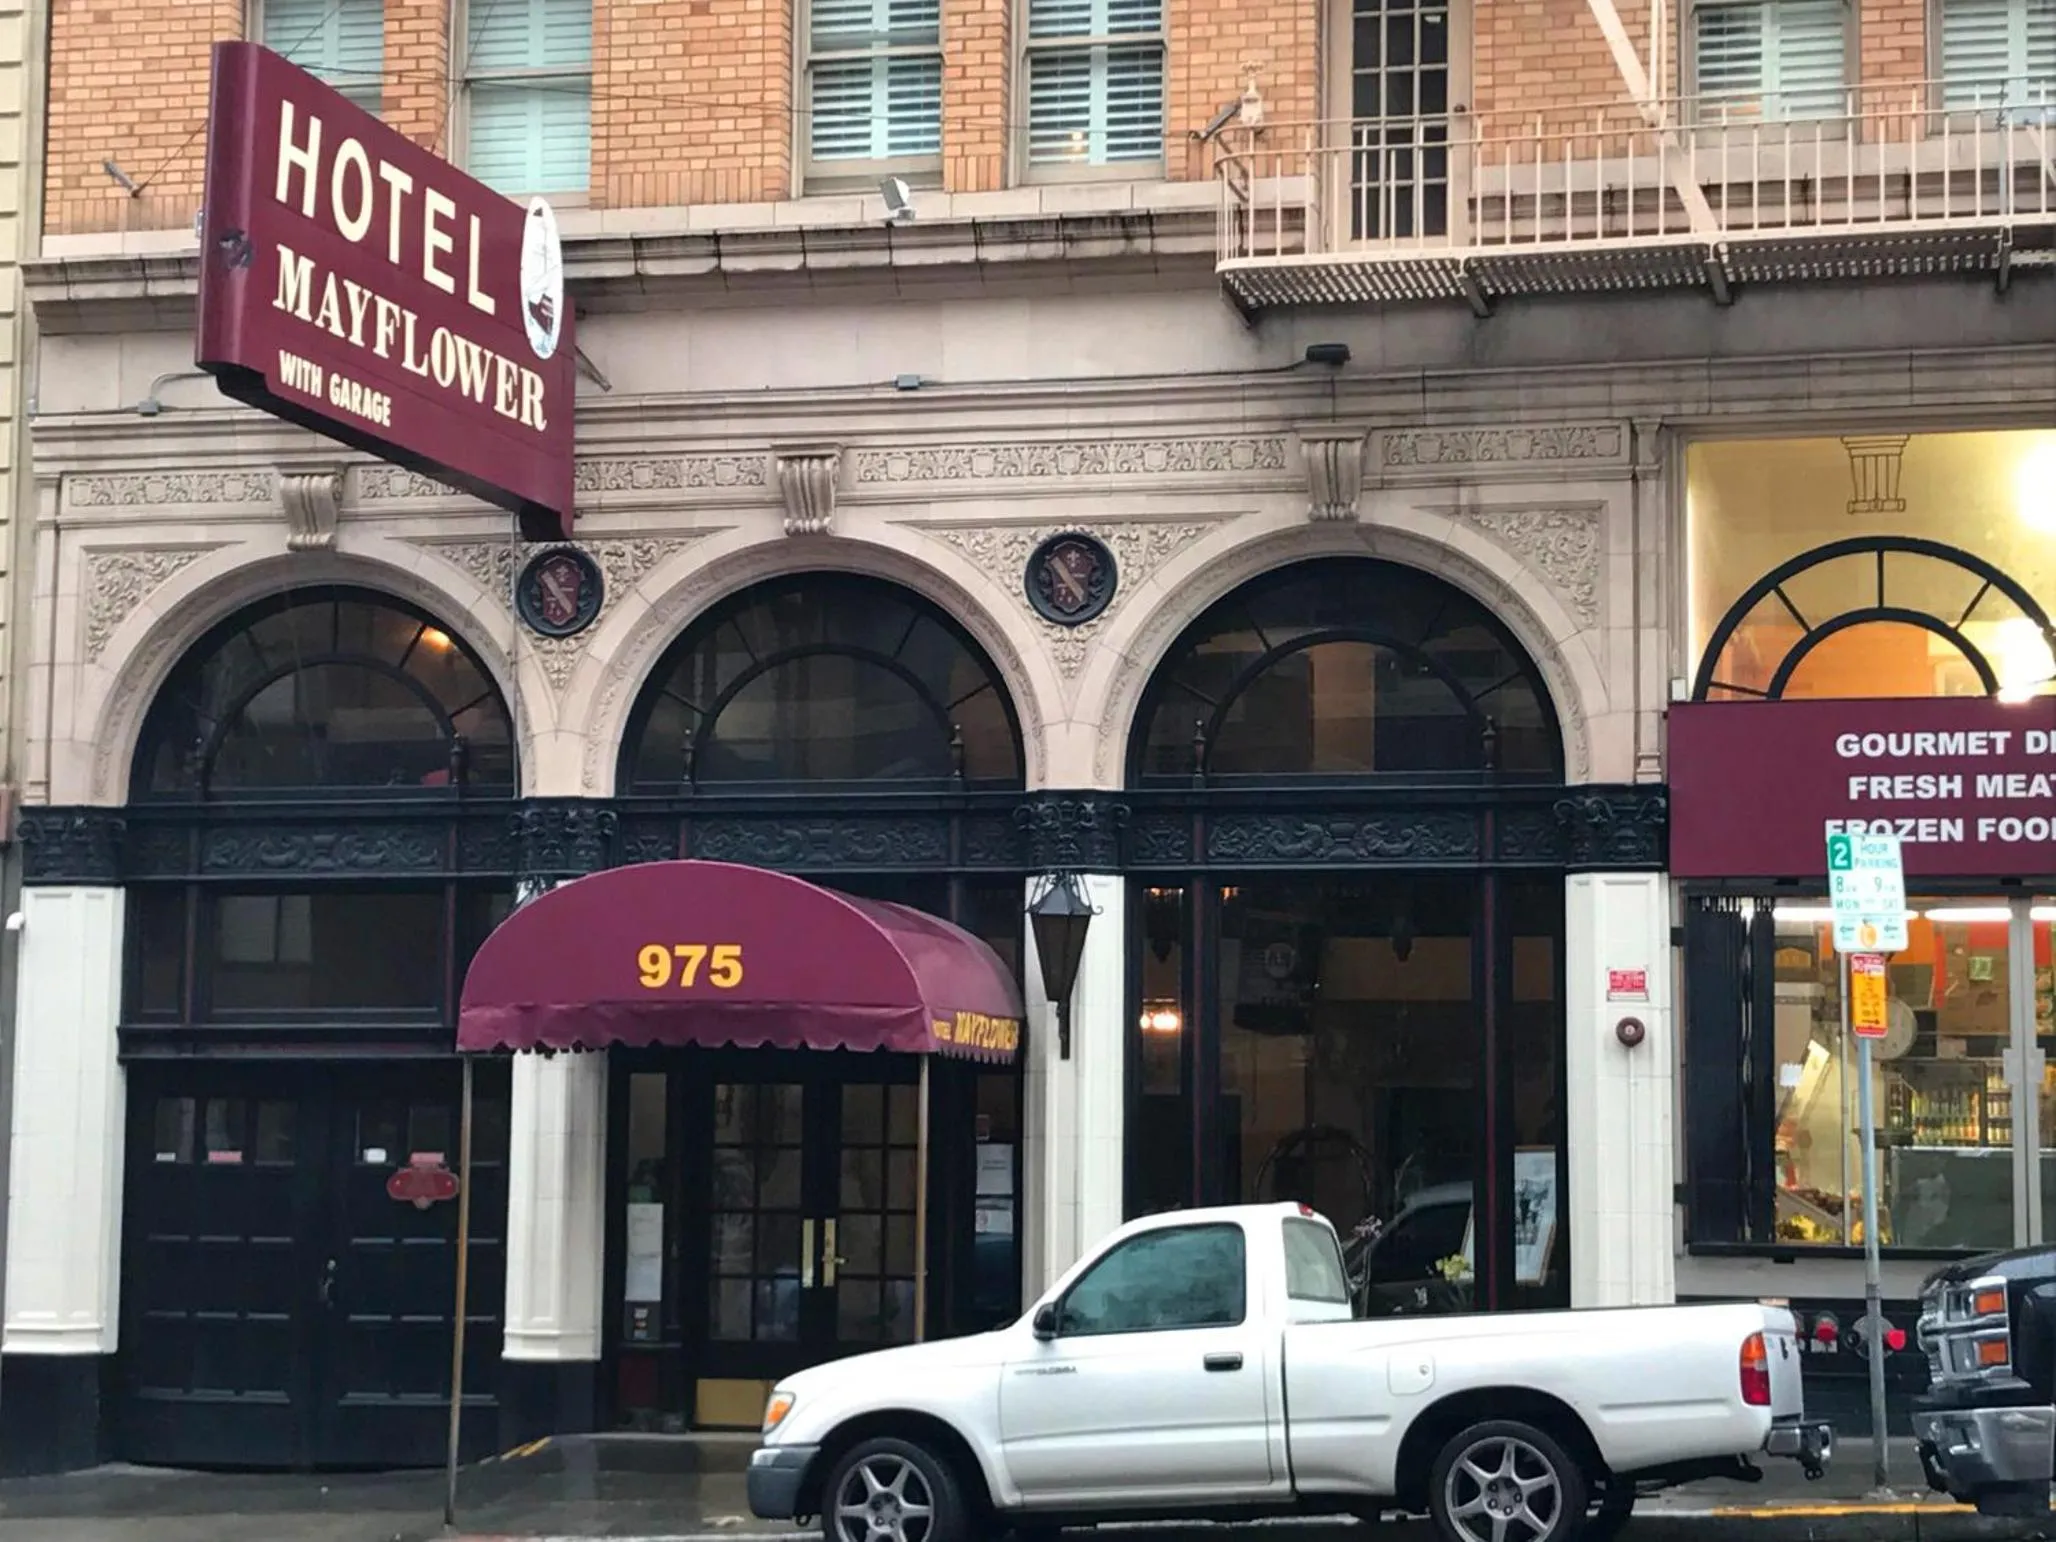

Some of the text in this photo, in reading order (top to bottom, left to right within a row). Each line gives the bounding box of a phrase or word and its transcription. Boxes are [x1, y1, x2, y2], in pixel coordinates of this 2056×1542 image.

[275, 99, 496, 316] HOTEL
[272, 243, 548, 432] MAYFLOWER
[279, 349, 392, 428] WITH GARAGE
[1835, 730, 2056, 758] GOURMET D
[1849, 773, 2056, 800] FRESH MEA
[1977, 816, 2056, 842] FOO
[1833, 842, 1848, 867] 2
[1860, 842, 1888, 854] HOUR
[1855, 858, 1898, 869] PARKING
[638, 944, 743, 988] 975
